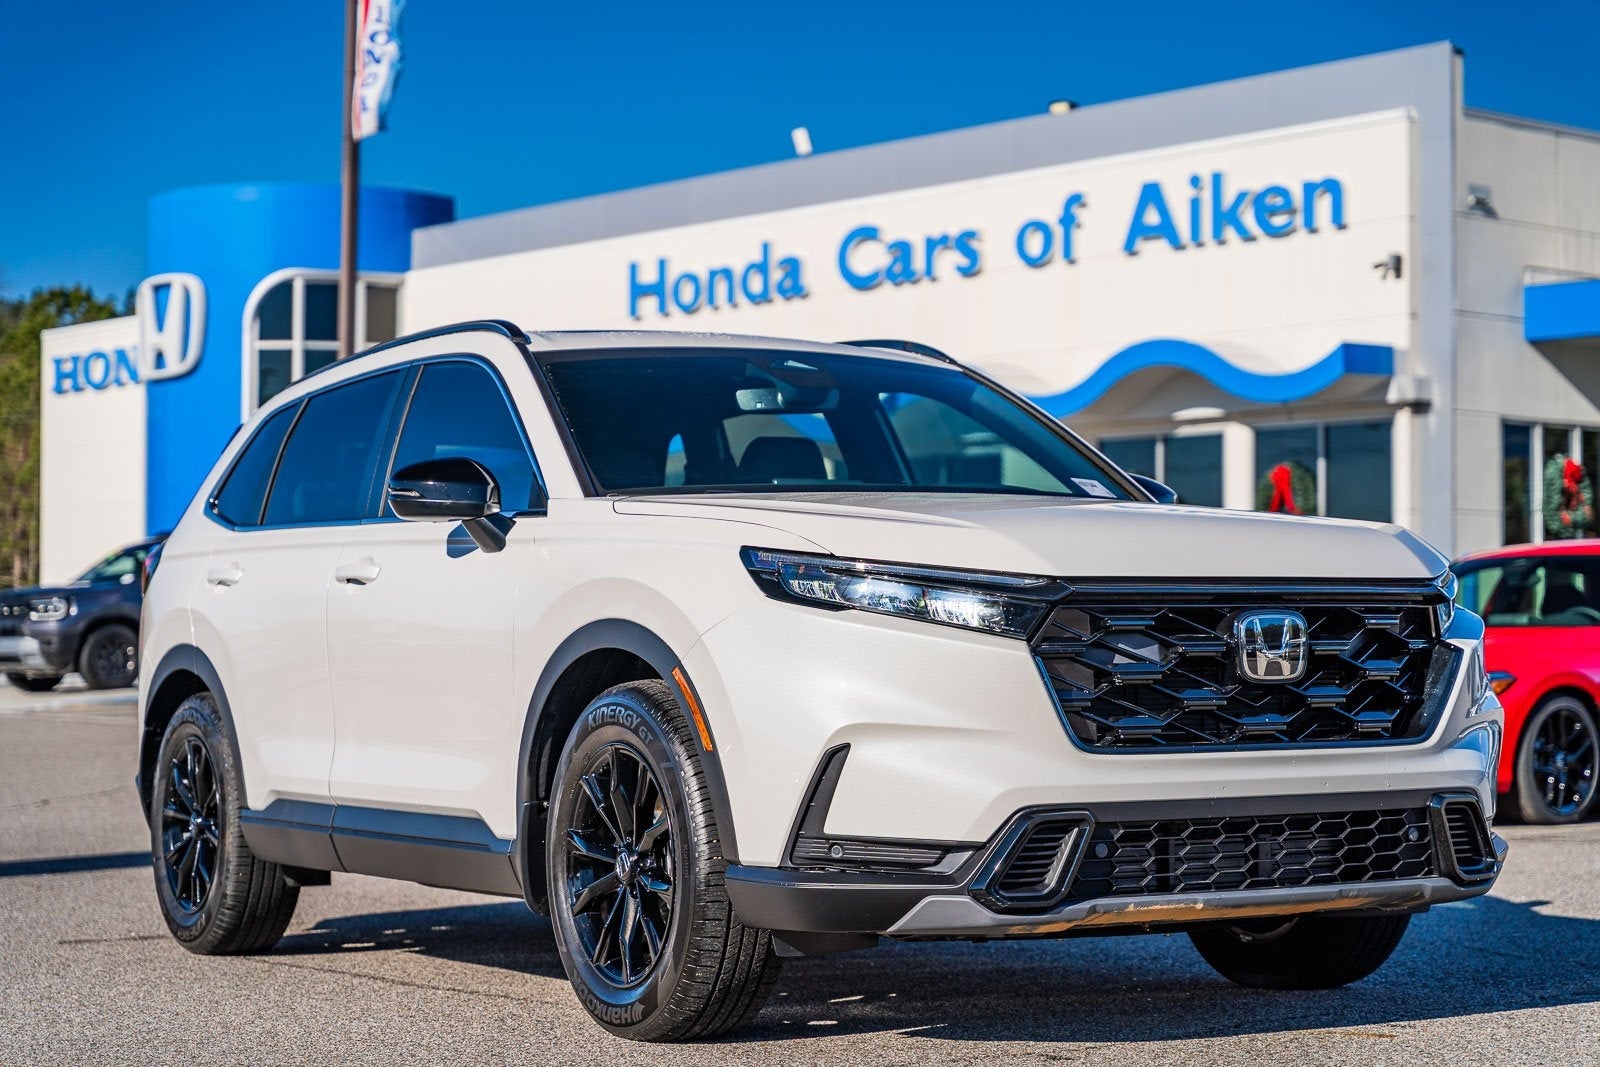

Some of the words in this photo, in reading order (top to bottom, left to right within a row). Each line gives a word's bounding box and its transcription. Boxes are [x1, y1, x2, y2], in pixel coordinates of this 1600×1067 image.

[628, 242, 807, 318] Honda
[838, 225, 982, 291] Cars
[1016, 193, 1085, 268] of
[1123, 172, 1345, 254] Aiken
[588, 705, 642, 731] KINERGY
[638, 726, 654, 745] GT
